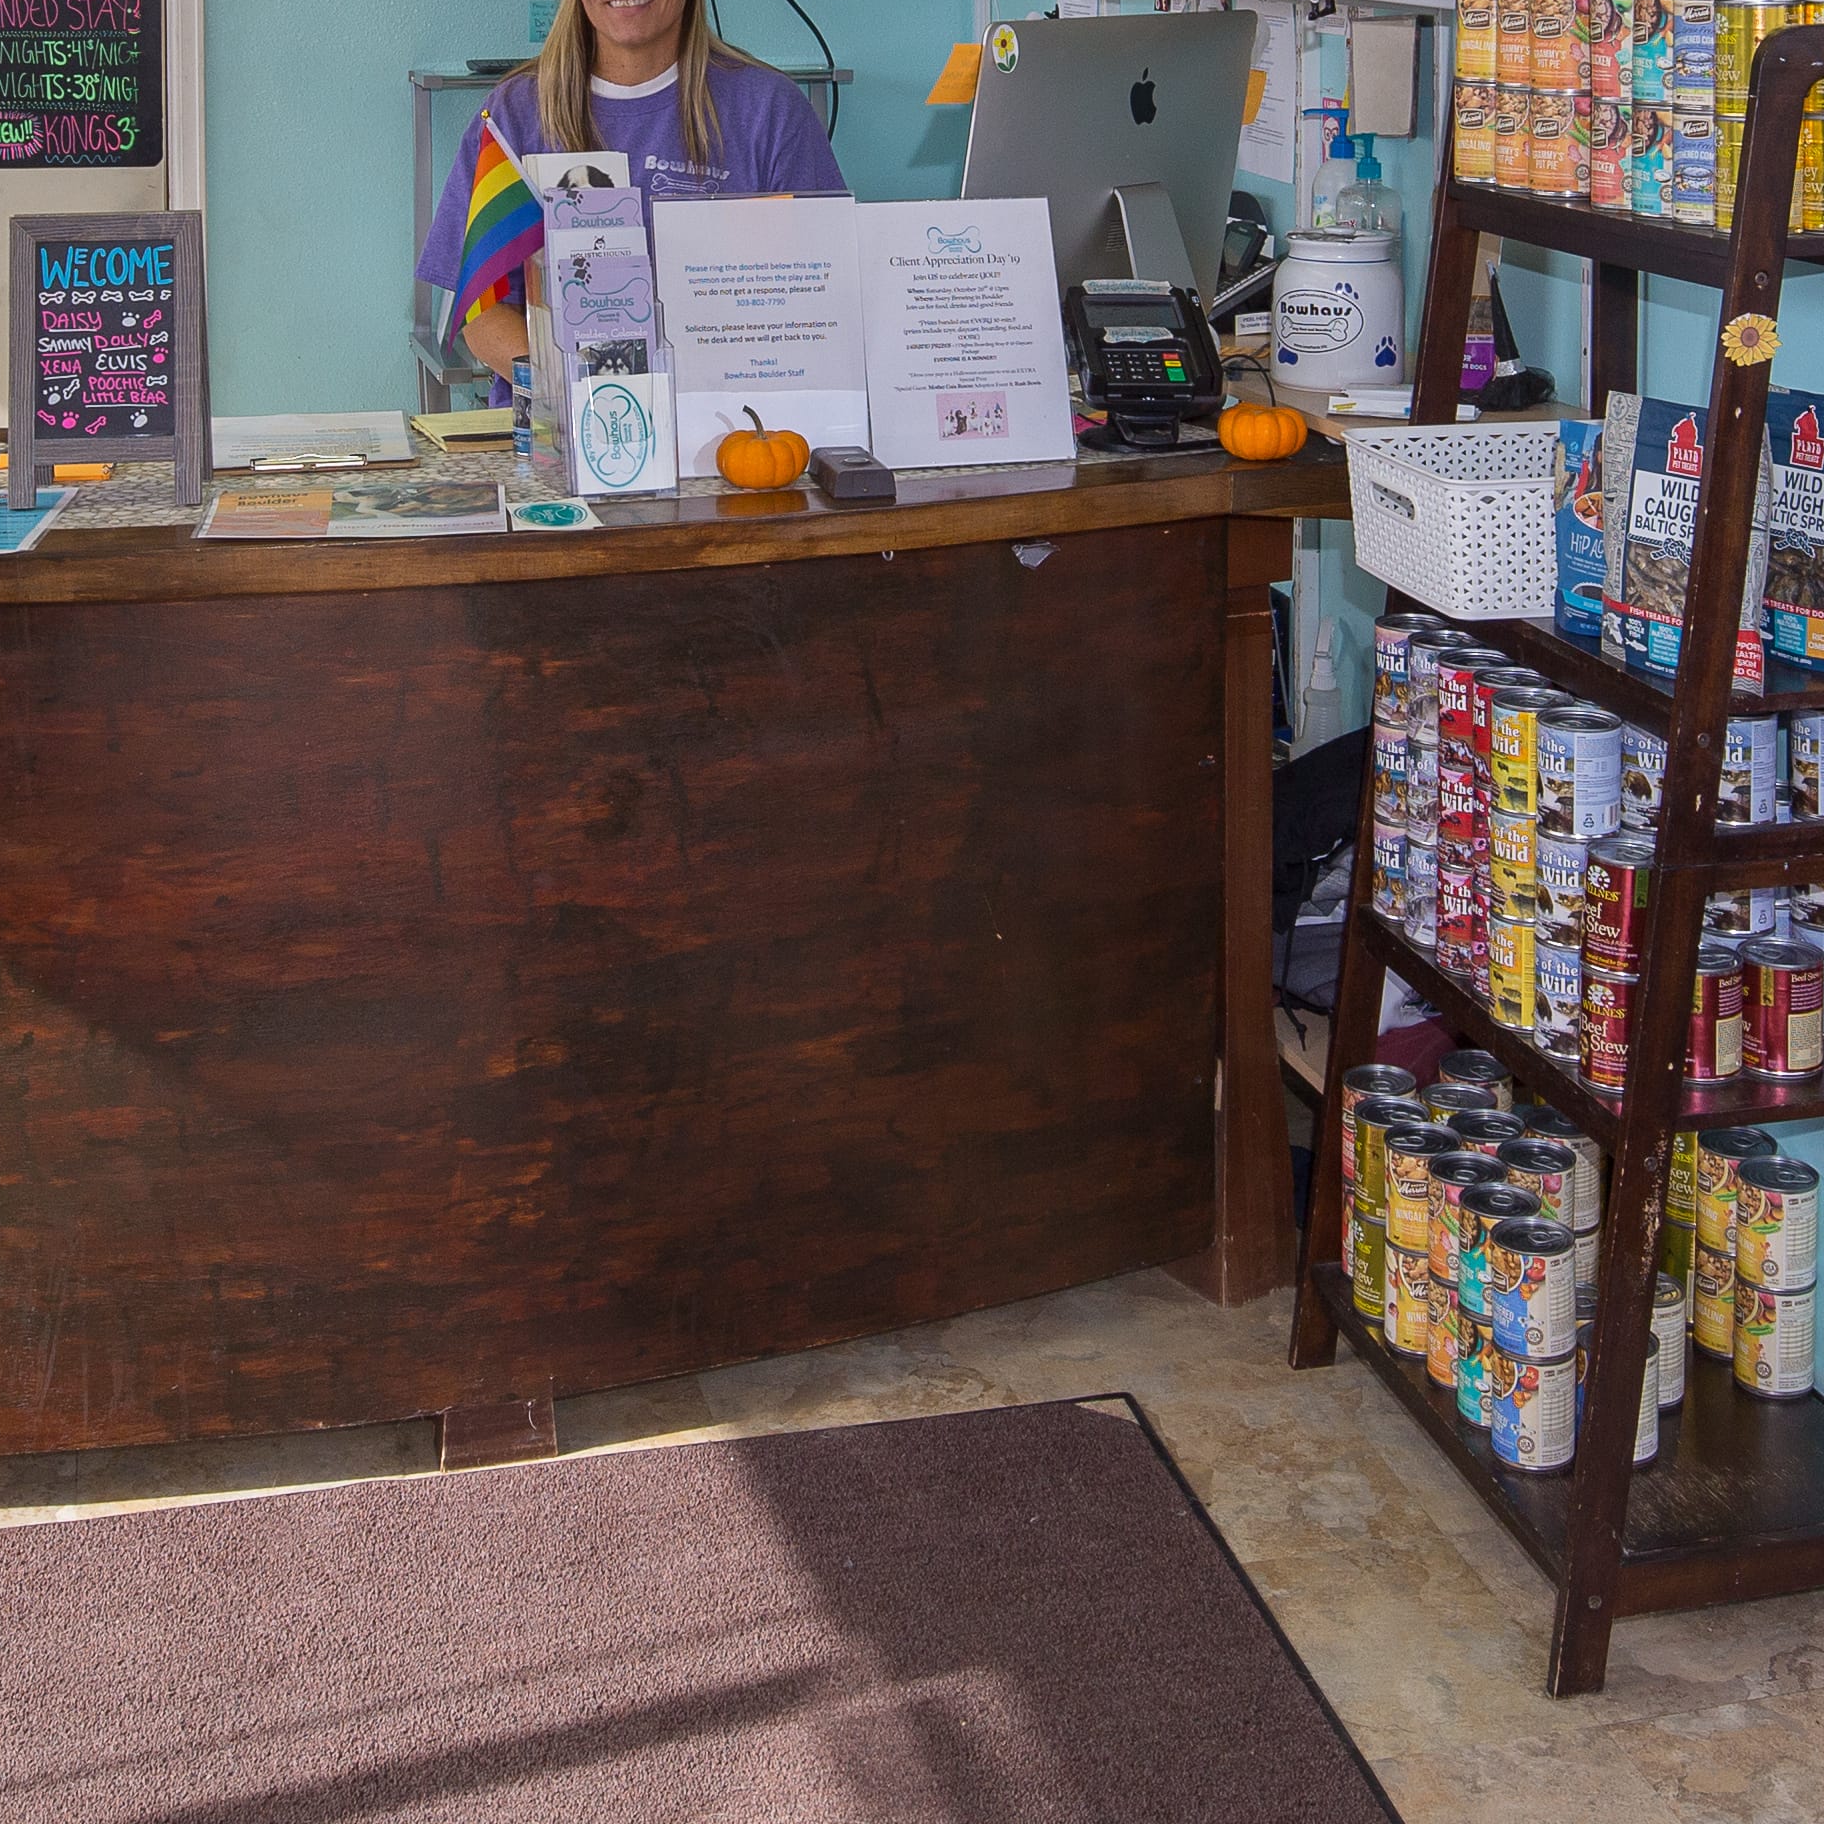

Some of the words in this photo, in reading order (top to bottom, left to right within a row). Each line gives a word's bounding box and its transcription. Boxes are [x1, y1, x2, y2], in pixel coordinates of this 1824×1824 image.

[43, 114, 121, 154] KONGS
[571, 217, 625, 227] Bowhaus
[40, 244, 174, 289] WELCOME
[738, 263, 769, 271] doorbell
[770, 262, 792, 270] below
[808, 262, 822, 270] sign
[889, 256, 920, 266] Client
[923, 255, 985, 268] Appreciation
[987, 254, 1005, 266] Day
[693, 289, 708, 297] you
[734, 288, 746, 296] get
[753, 287, 788, 295] response,
[789, 285, 812, 294] please
[580, 297, 635, 309] Bowhaus
[736, 298, 786, 307] 303-802-7790
[1280, 301, 1352, 316] Bowhaus
[42, 311, 103, 331] DAISY
[685, 324, 720, 333] Solicitors,
[722, 324, 745, 332] please
[746, 323, 765, 331] leave
[767, 323, 783, 331] your
[785, 321, 826, 329] information
[38, 337, 93, 353] SAMMY
[94, 333, 149, 348] DOLLY
[40, 359, 83, 375] XENA
[95, 354, 149, 371] ELVIS
[750, 358, 778, 366] Thanks!
[724, 371, 757, 379] Bowhaus
[788, 369, 805, 377] Staff
[89, 376, 146, 391] POOCHIE
[129, 390, 168, 404] BEAR
[609, 411, 621, 460] Bowhaus
[1673, 447, 1698, 462] PLATO
[1796, 439, 1821, 455] PLATO
[1785, 471, 1822, 493] WILD
[1662, 479, 1700, 502] WILD
[1635, 515, 1677, 536] BALTIC
[1770, 600, 1794, 612] TREATS
[1796, 606, 1810, 616] FOR
[1390, 643, 1405, 656] the
[1376, 655, 1406, 673] Wild
[1450, 679, 1467, 694] the
[1494, 842, 1529, 864] Wild
[1586, 919, 1621, 939] Stew
[1581, 1014, 1609, 1035] Beef
[1590, 1034, 1628, 1056] Stew
